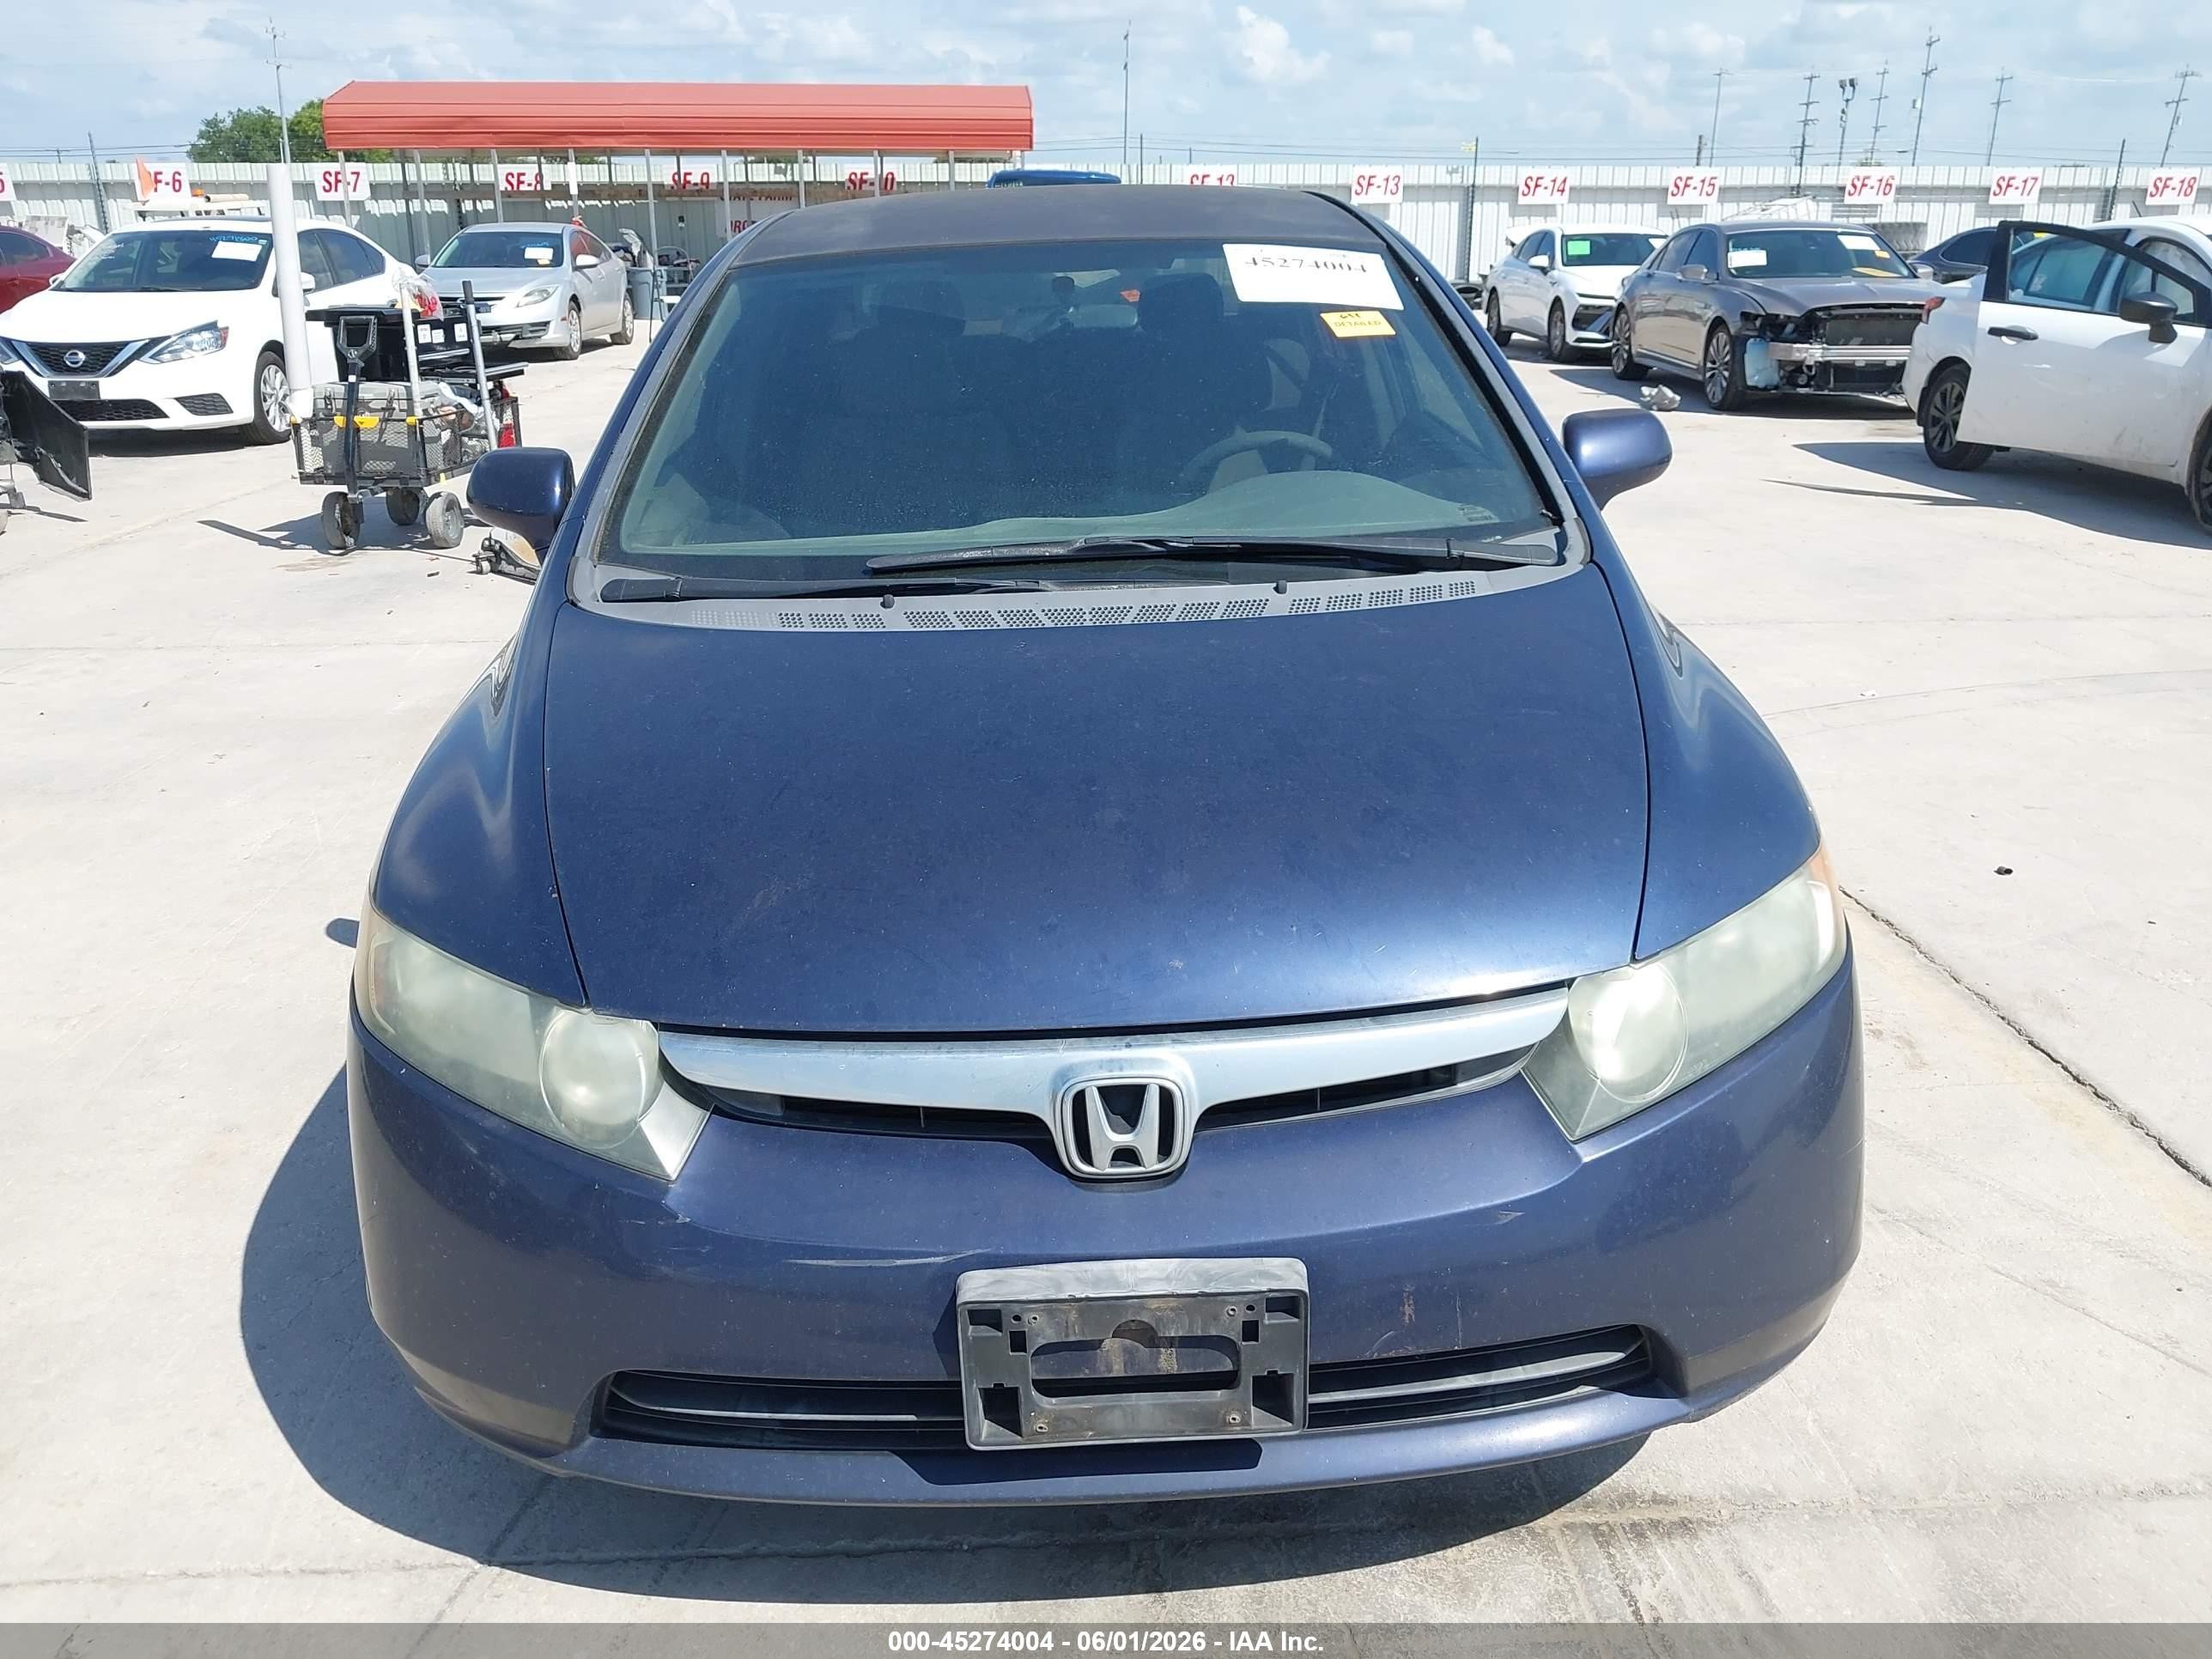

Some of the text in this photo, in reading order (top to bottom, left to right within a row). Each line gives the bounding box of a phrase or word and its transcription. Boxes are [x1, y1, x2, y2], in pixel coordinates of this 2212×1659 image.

[153, 171, 182, 192] F-6
[322, 170, 361, 192] SF-7
[848, 172, 895, 191] SF-0
[1354, 174, 1401, 195] SF-13
[1522, 176, 1567, 197] SF-14
[1671, 177, 1717, 197] SF-15
[1848, 176, 1895, 197] SF-16
[1993, 177, 2039, 196] SF-17
[2149, 177, 2197, 197] SF-18
